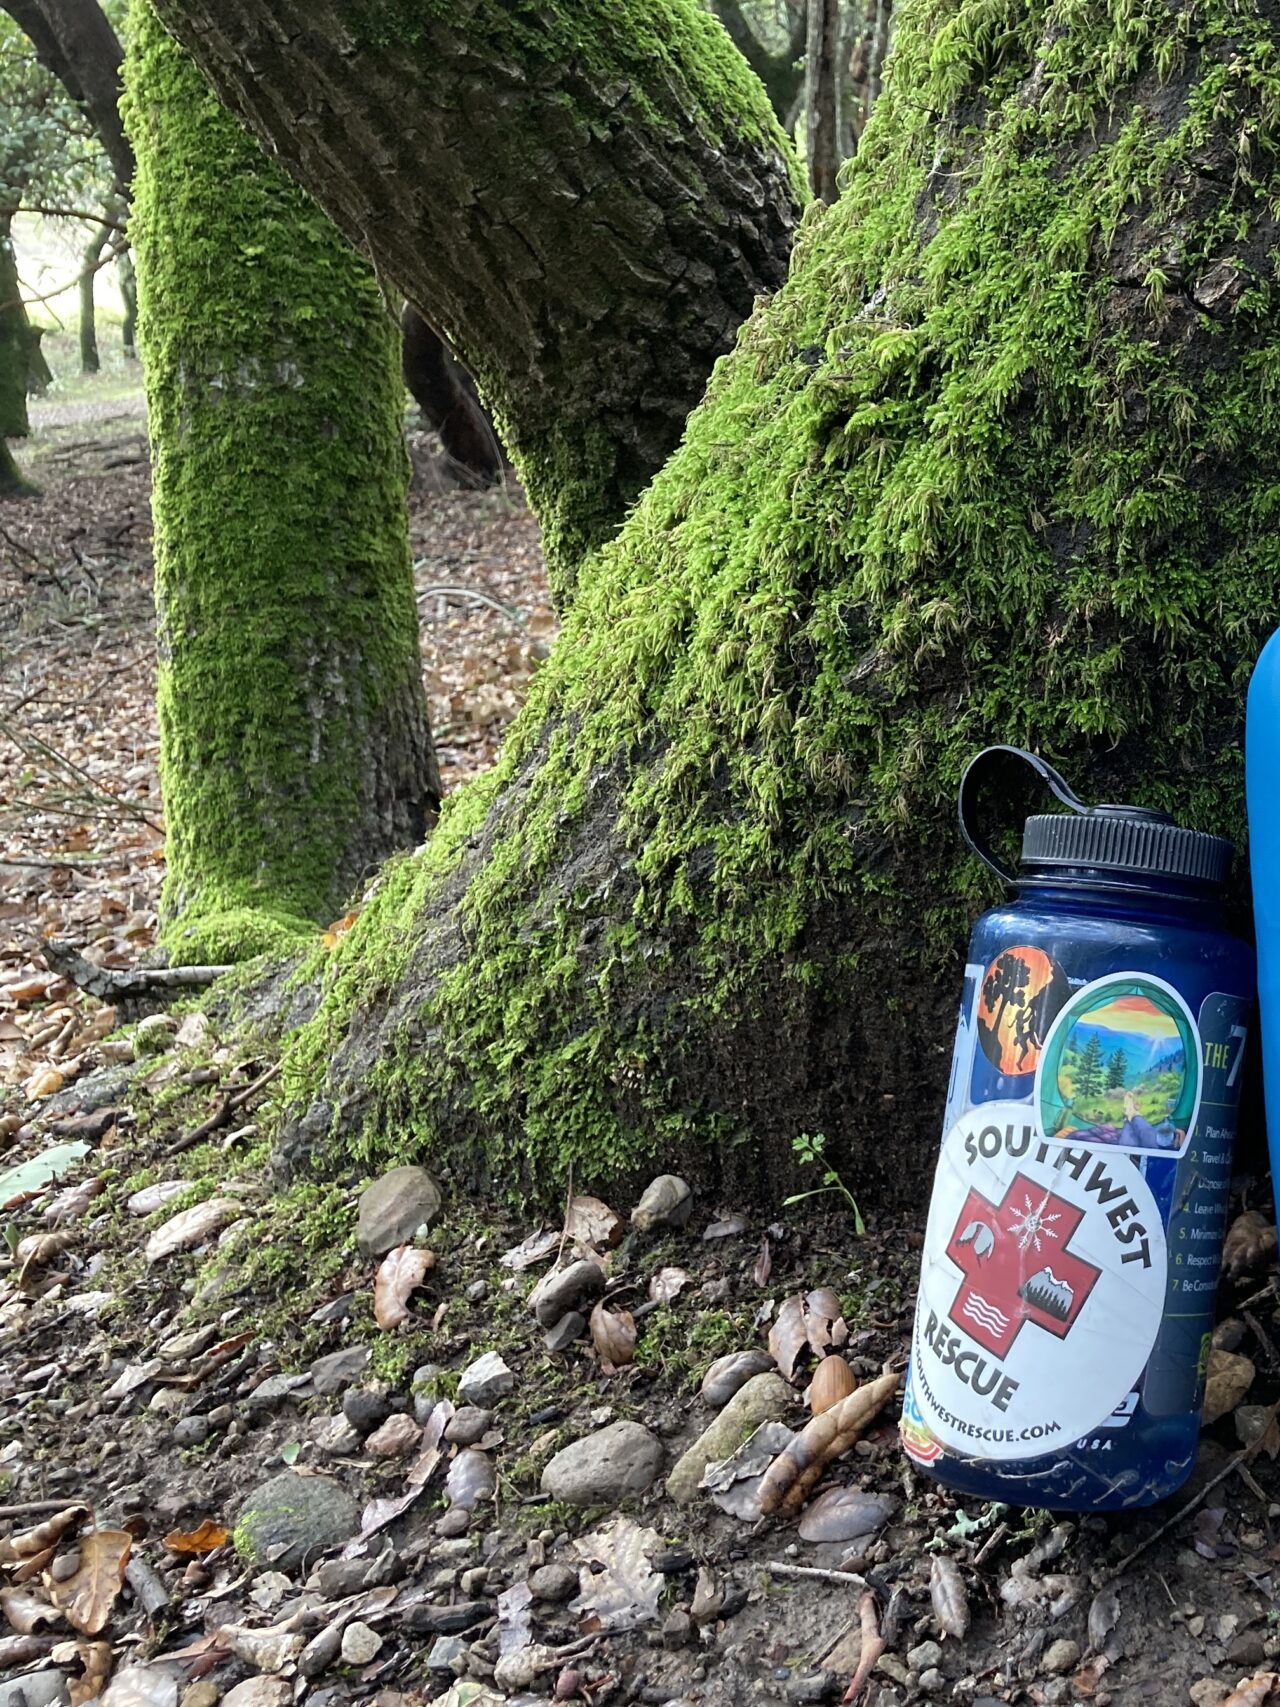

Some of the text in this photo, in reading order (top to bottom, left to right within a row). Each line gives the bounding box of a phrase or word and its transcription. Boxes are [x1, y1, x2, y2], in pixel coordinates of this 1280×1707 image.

[1203, 1024, 1247, 1087] THE 7
[1182, 1280, 1193, 1292] Be
[924, 1310, 1020, 1413] RESCUE
